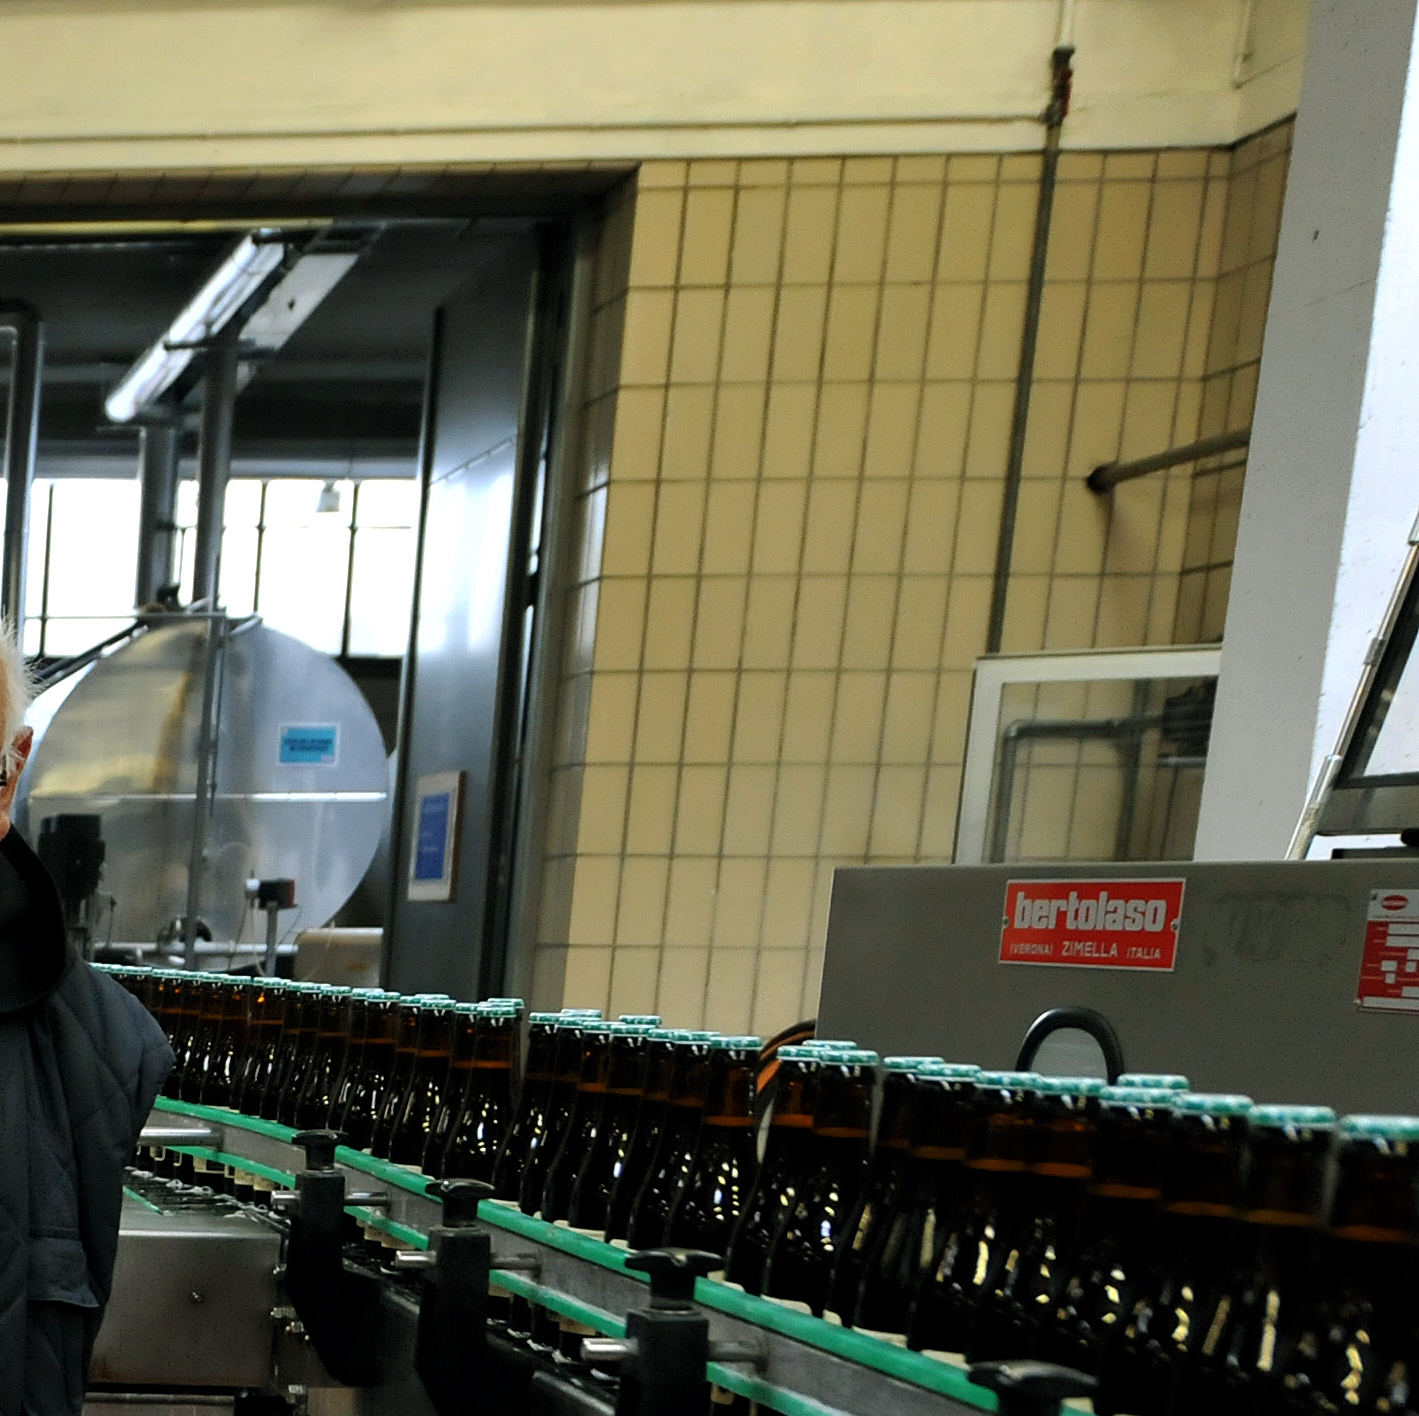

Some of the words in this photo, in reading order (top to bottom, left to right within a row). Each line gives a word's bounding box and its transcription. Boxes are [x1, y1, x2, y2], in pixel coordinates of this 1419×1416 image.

[1014, 890, 1167, 932] bertolaso
[1061, 941, 1119, 958] ZIMELLA
[1126, 946, 1162, 960] ITALIA
